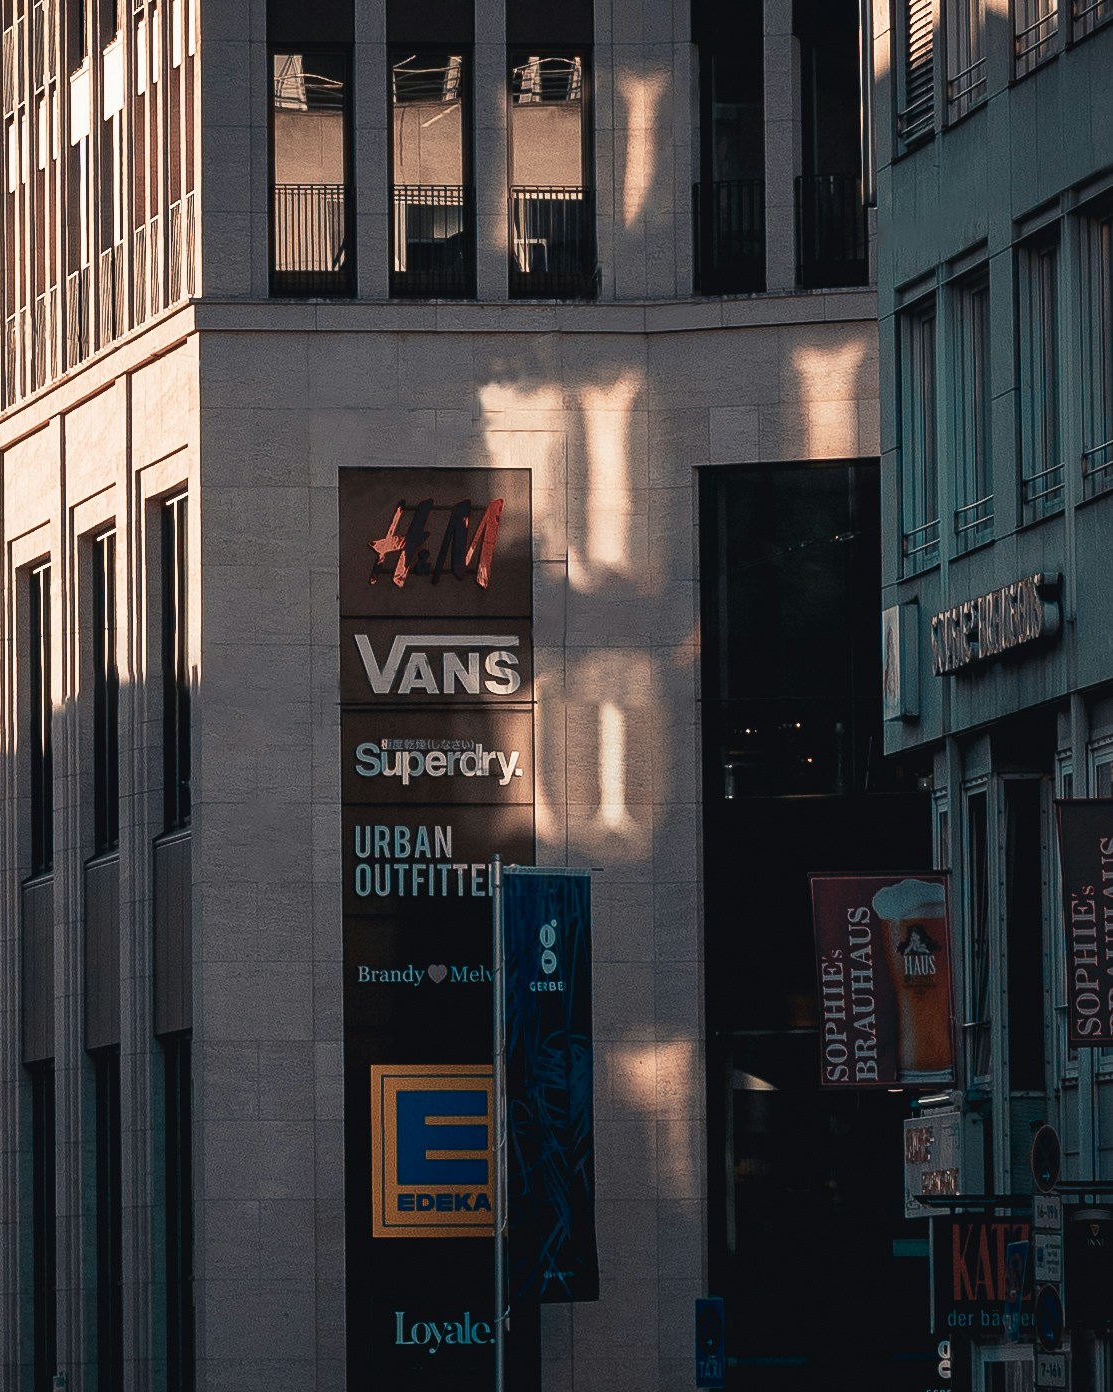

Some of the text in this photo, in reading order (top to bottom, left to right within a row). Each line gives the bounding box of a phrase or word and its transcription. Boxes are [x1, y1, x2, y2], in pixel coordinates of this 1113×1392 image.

[367, 498, 504, 590] H&M
[353, 634, 521, 696] VANS
[355, 825, 452, 858] URBAN
[355, 863, 493, 897] OUTFITTE
[357, 964, 426, 987] Brandy
[904, 955, 936, 976] HAUS
[529, 980, 567, 992] GERBE
[847, 906, 878, 1082] BRAUHAUS
[397, 1193, 492, 1212] EDEKA
[947, 1309, 975, 1327] der
